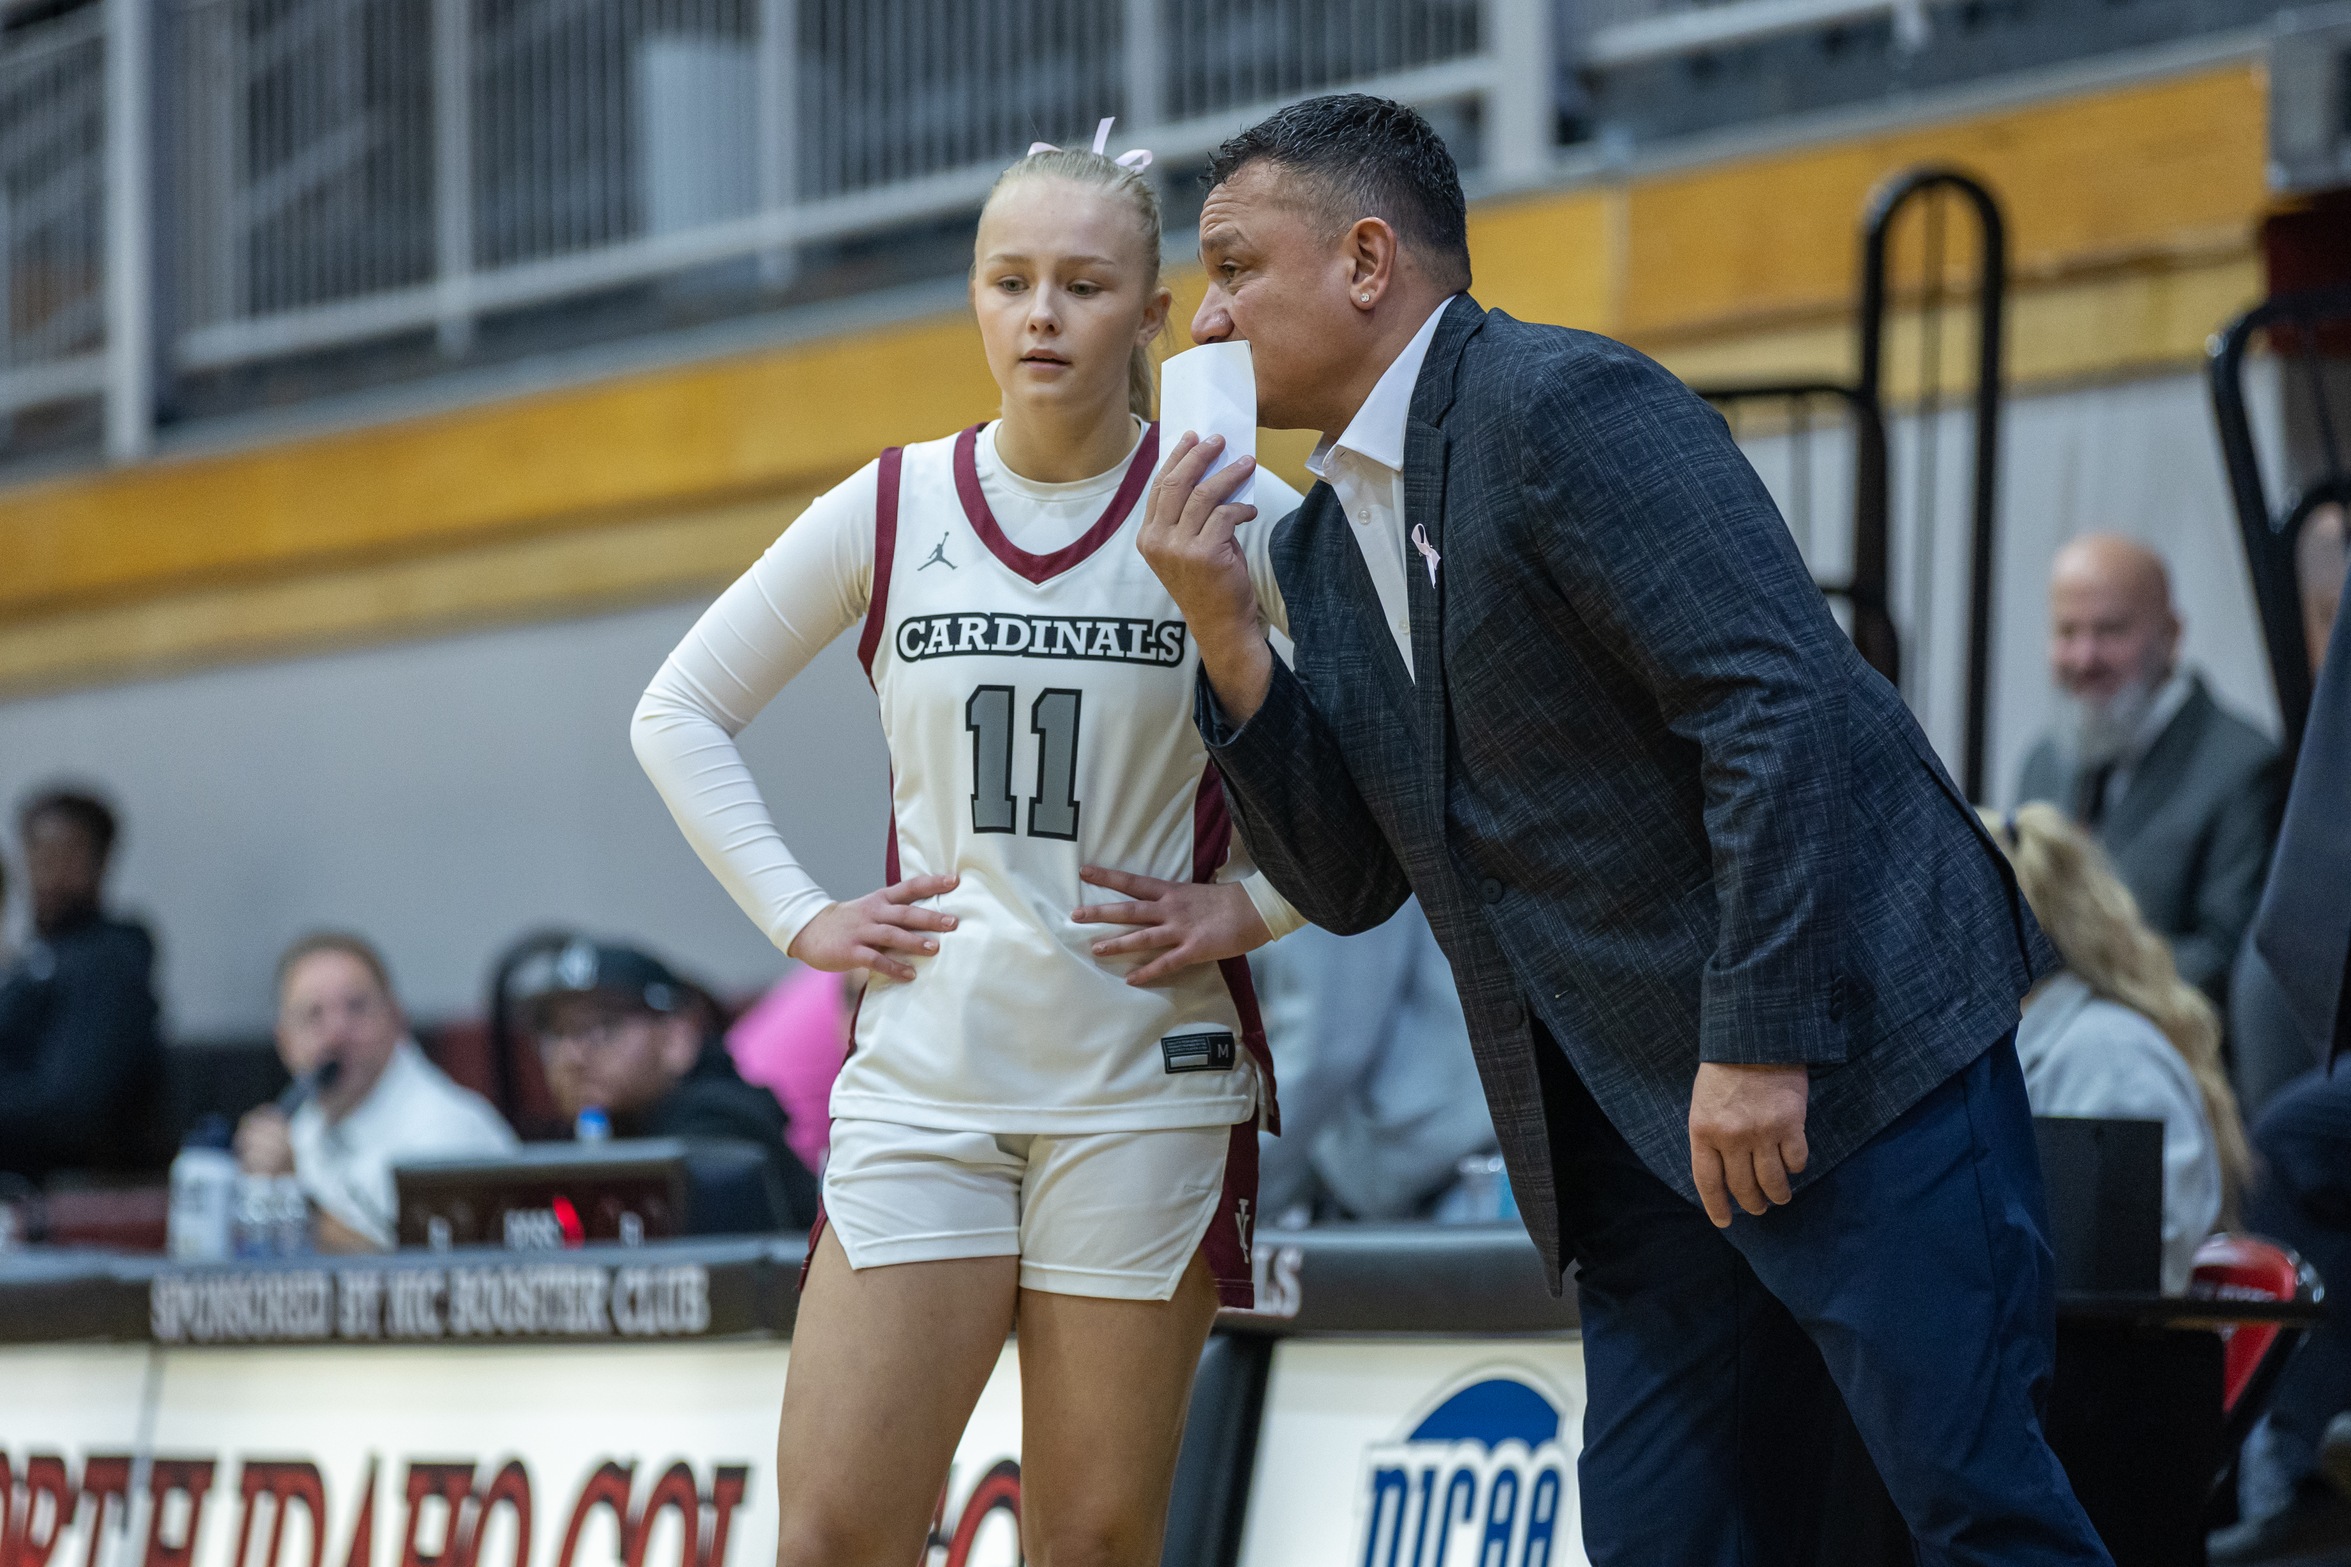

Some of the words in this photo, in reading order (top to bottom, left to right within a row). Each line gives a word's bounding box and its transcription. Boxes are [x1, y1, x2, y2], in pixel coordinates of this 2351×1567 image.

[897, 613, 1186, 668] CARDINALS
[965, 684, 1083, 842] 11
[1217, 1043, 1229, 1058] M
[612, 1263, 710, 1335] CLUB
